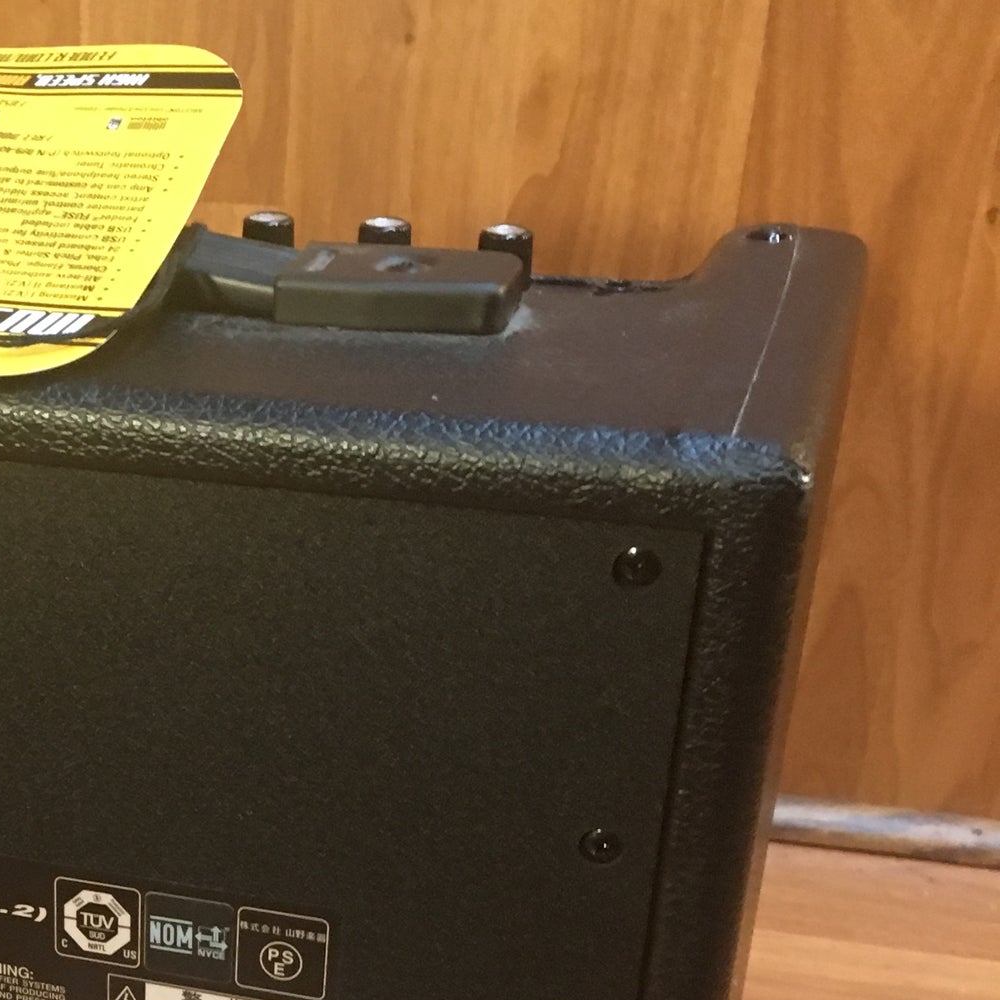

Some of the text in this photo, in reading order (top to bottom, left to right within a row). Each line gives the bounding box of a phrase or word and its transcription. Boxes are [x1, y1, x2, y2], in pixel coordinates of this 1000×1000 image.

[149, 920, 192, 949] NOM
[61, 938, 67, 947] C
[123, 948, 136, 959] US
